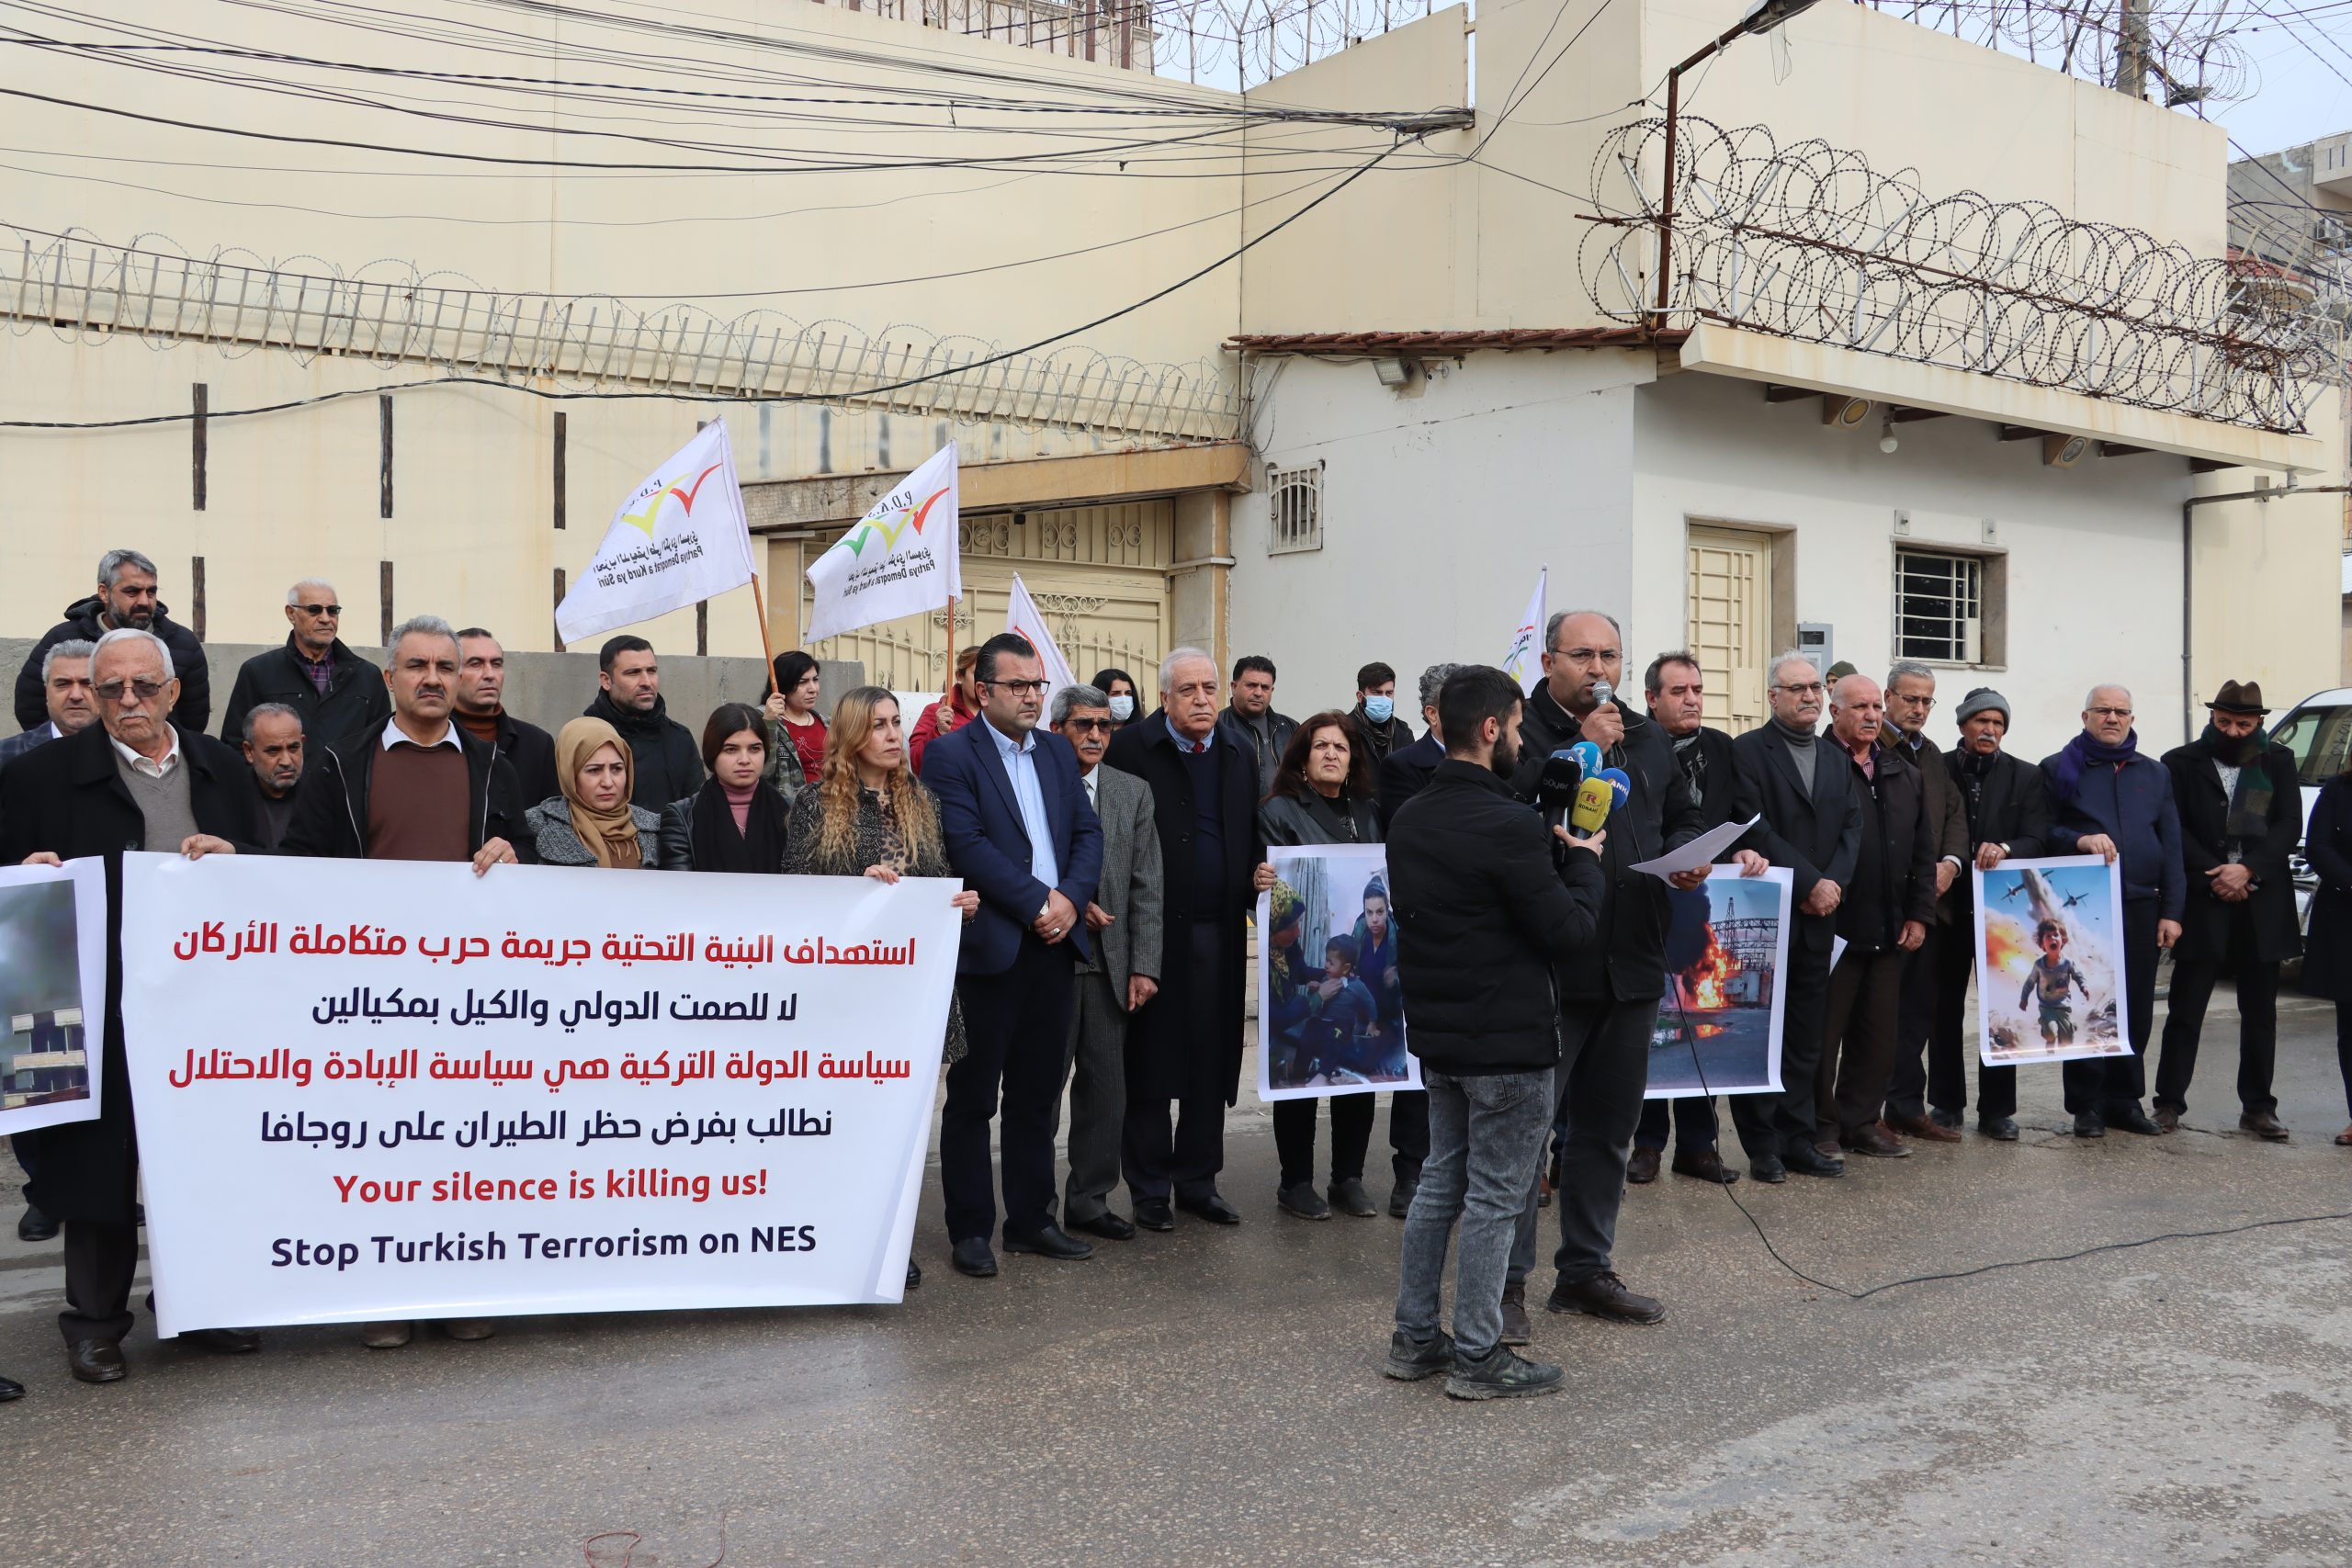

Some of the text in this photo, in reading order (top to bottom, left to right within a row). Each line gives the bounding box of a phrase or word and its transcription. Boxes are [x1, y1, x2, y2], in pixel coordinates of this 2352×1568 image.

[175, 920, 915, 969] استهداف البنية التحتية جريمة حرب متكاملة الأركان
[311, 987, 797, 1033] لا للصمت الدولي والكيل بمكيالين
[169, 1049, 910, 1094] سياسة الدولة التركية هي سياسة الإبادة والاحتلال
[262, 1108, 831, 1149] نطالب بفرض حظر الطيران على روجافا
[334, 1168, 767, 1203] Your silence is killing us!
[271, 1225, 817, 1271] Stop Turkish Terrorism on NES
